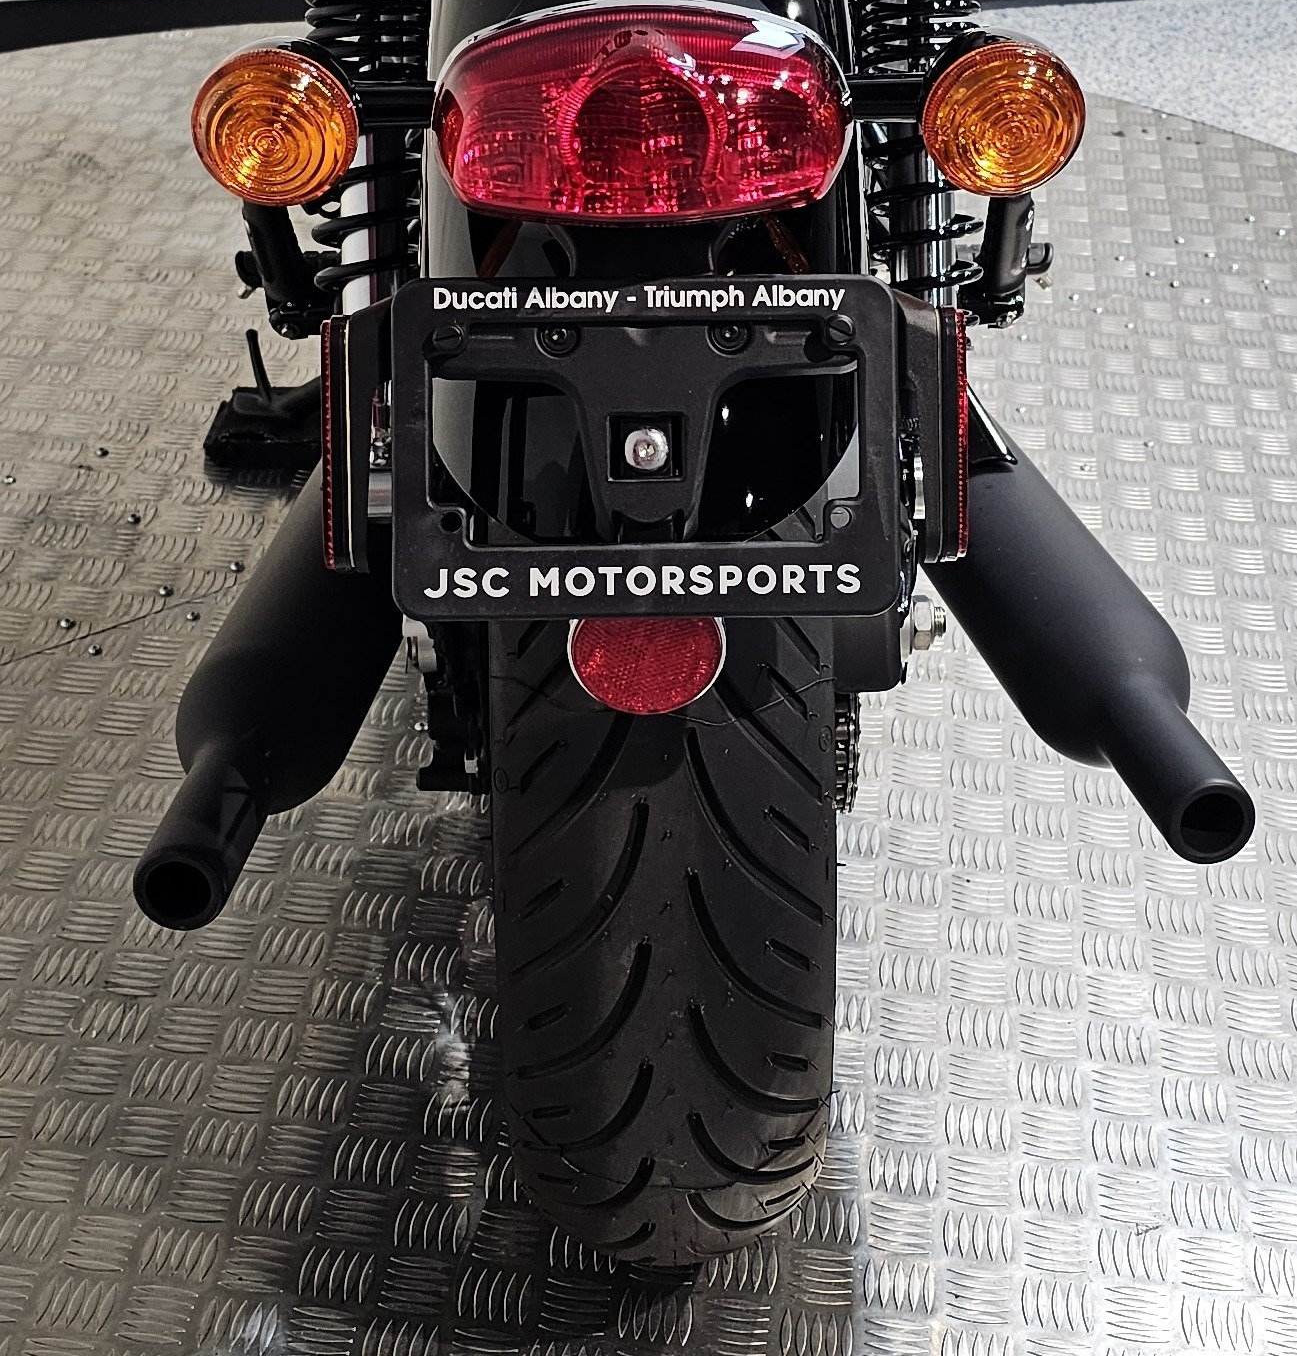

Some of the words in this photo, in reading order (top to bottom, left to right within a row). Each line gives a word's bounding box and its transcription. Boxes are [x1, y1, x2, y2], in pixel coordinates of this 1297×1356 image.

[433, 286, 518, 310] Ducati
[524, 286, 620, 313] Albany
[643, 285, 745, 313] Triumph
[751, 284, 846, 311] Albany
[423, 567, 510, 599] JSC
[529, 563, 861, 597] MOTORSPORTS
